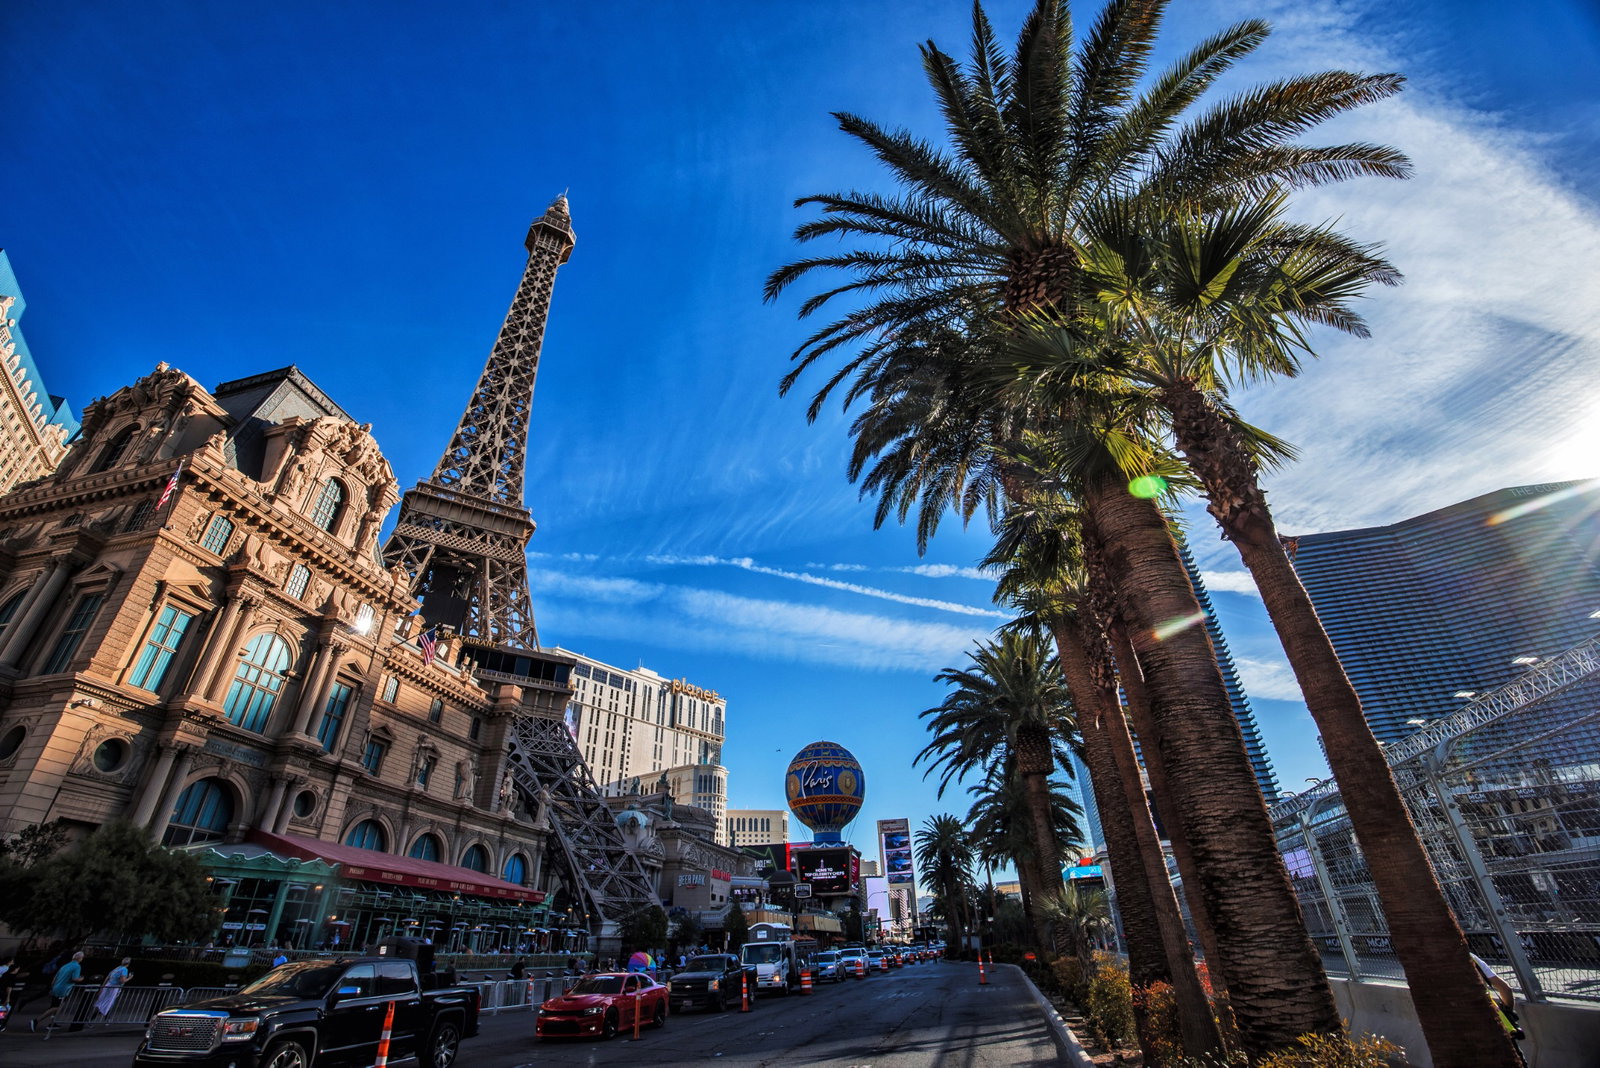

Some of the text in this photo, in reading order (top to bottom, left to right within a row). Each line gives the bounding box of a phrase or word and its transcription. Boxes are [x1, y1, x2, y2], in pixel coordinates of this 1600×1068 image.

[444, 631, 498, 648] RESTAURANT
[672, 677, 719, 703] planet
[802, 760, 833, 799] Paris
[679, 875, 691, 886] BEER
[692, 875, 705, 886] PARK
[1367, 938, 1389, 947] MGM
